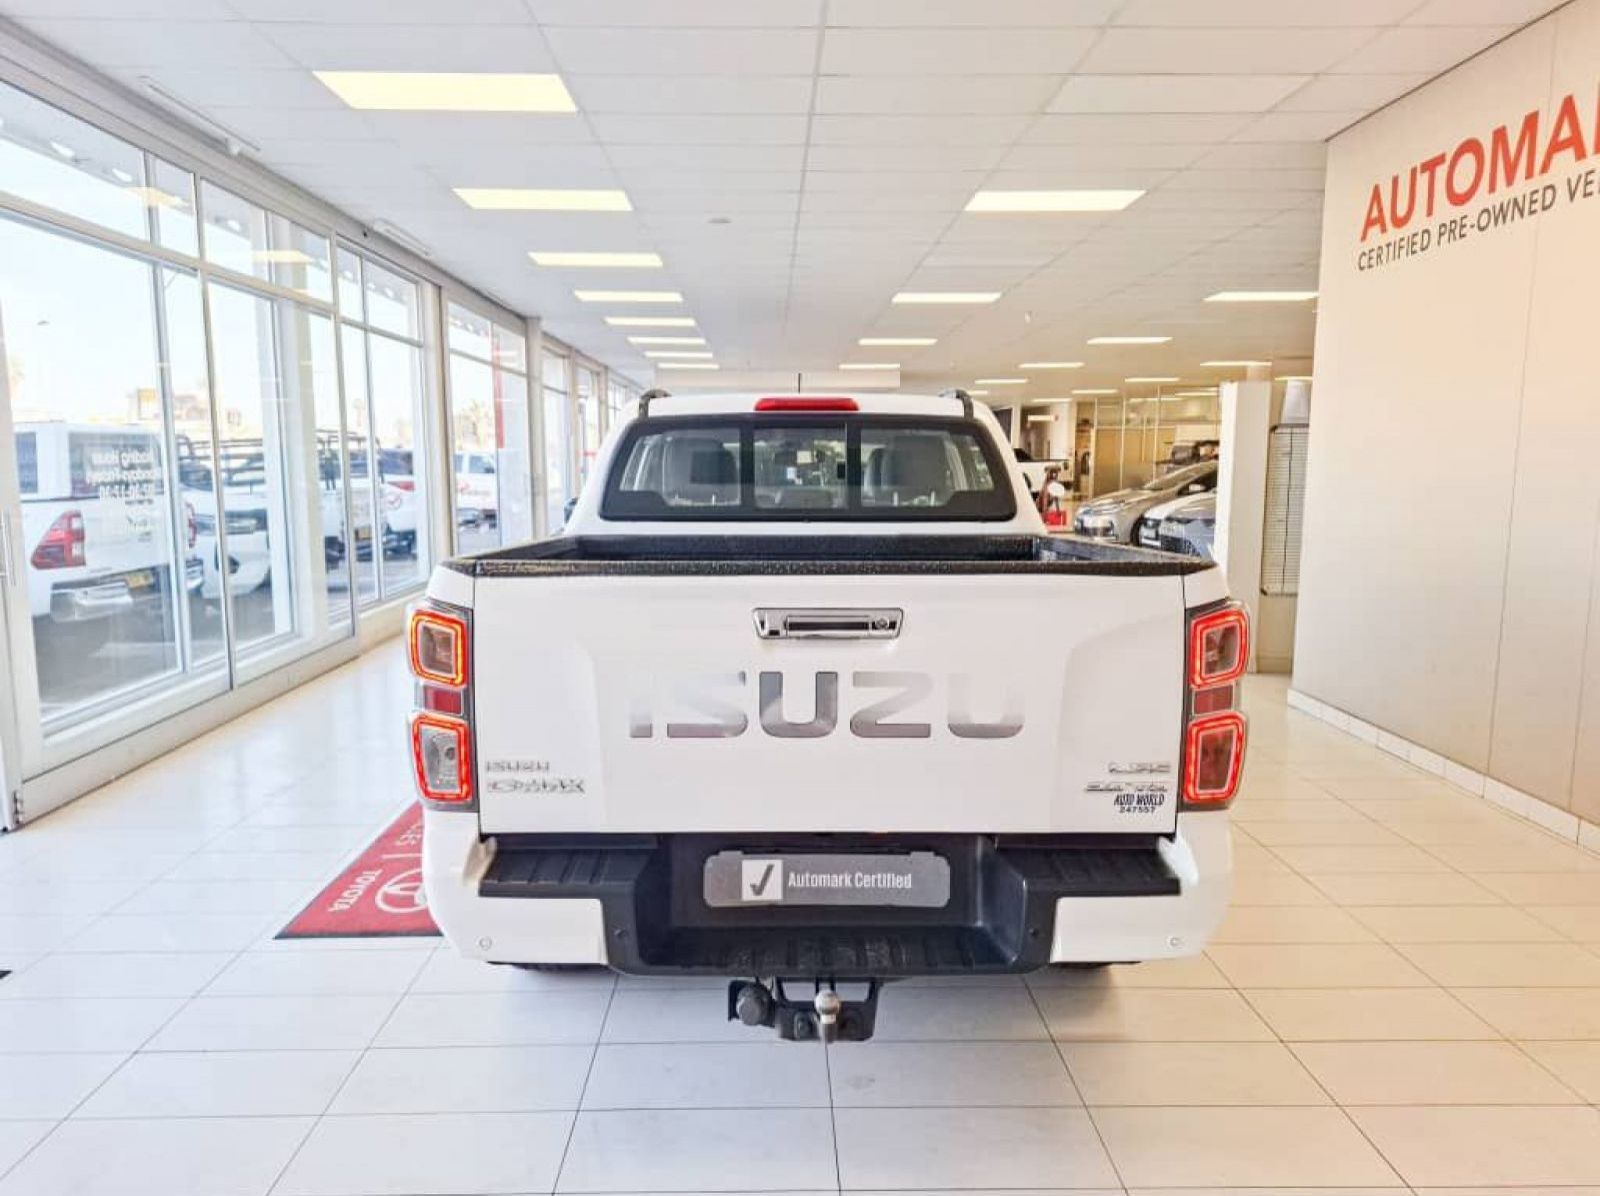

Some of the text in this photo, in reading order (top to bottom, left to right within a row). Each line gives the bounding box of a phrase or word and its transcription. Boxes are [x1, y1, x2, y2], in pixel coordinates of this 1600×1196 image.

[1360, 80, 1600, 242] AUTOMA
[1358, 169, 1600, 271] CERTIFIED PRE-OWNED VE
[628, 671, 1025, 738] ISUZU
[1114, 793, 1165, 806] AUTO WORLD
[328, 867, 384, 913] TOYOTA
[788, 871, 912, 888] Automark Certified
